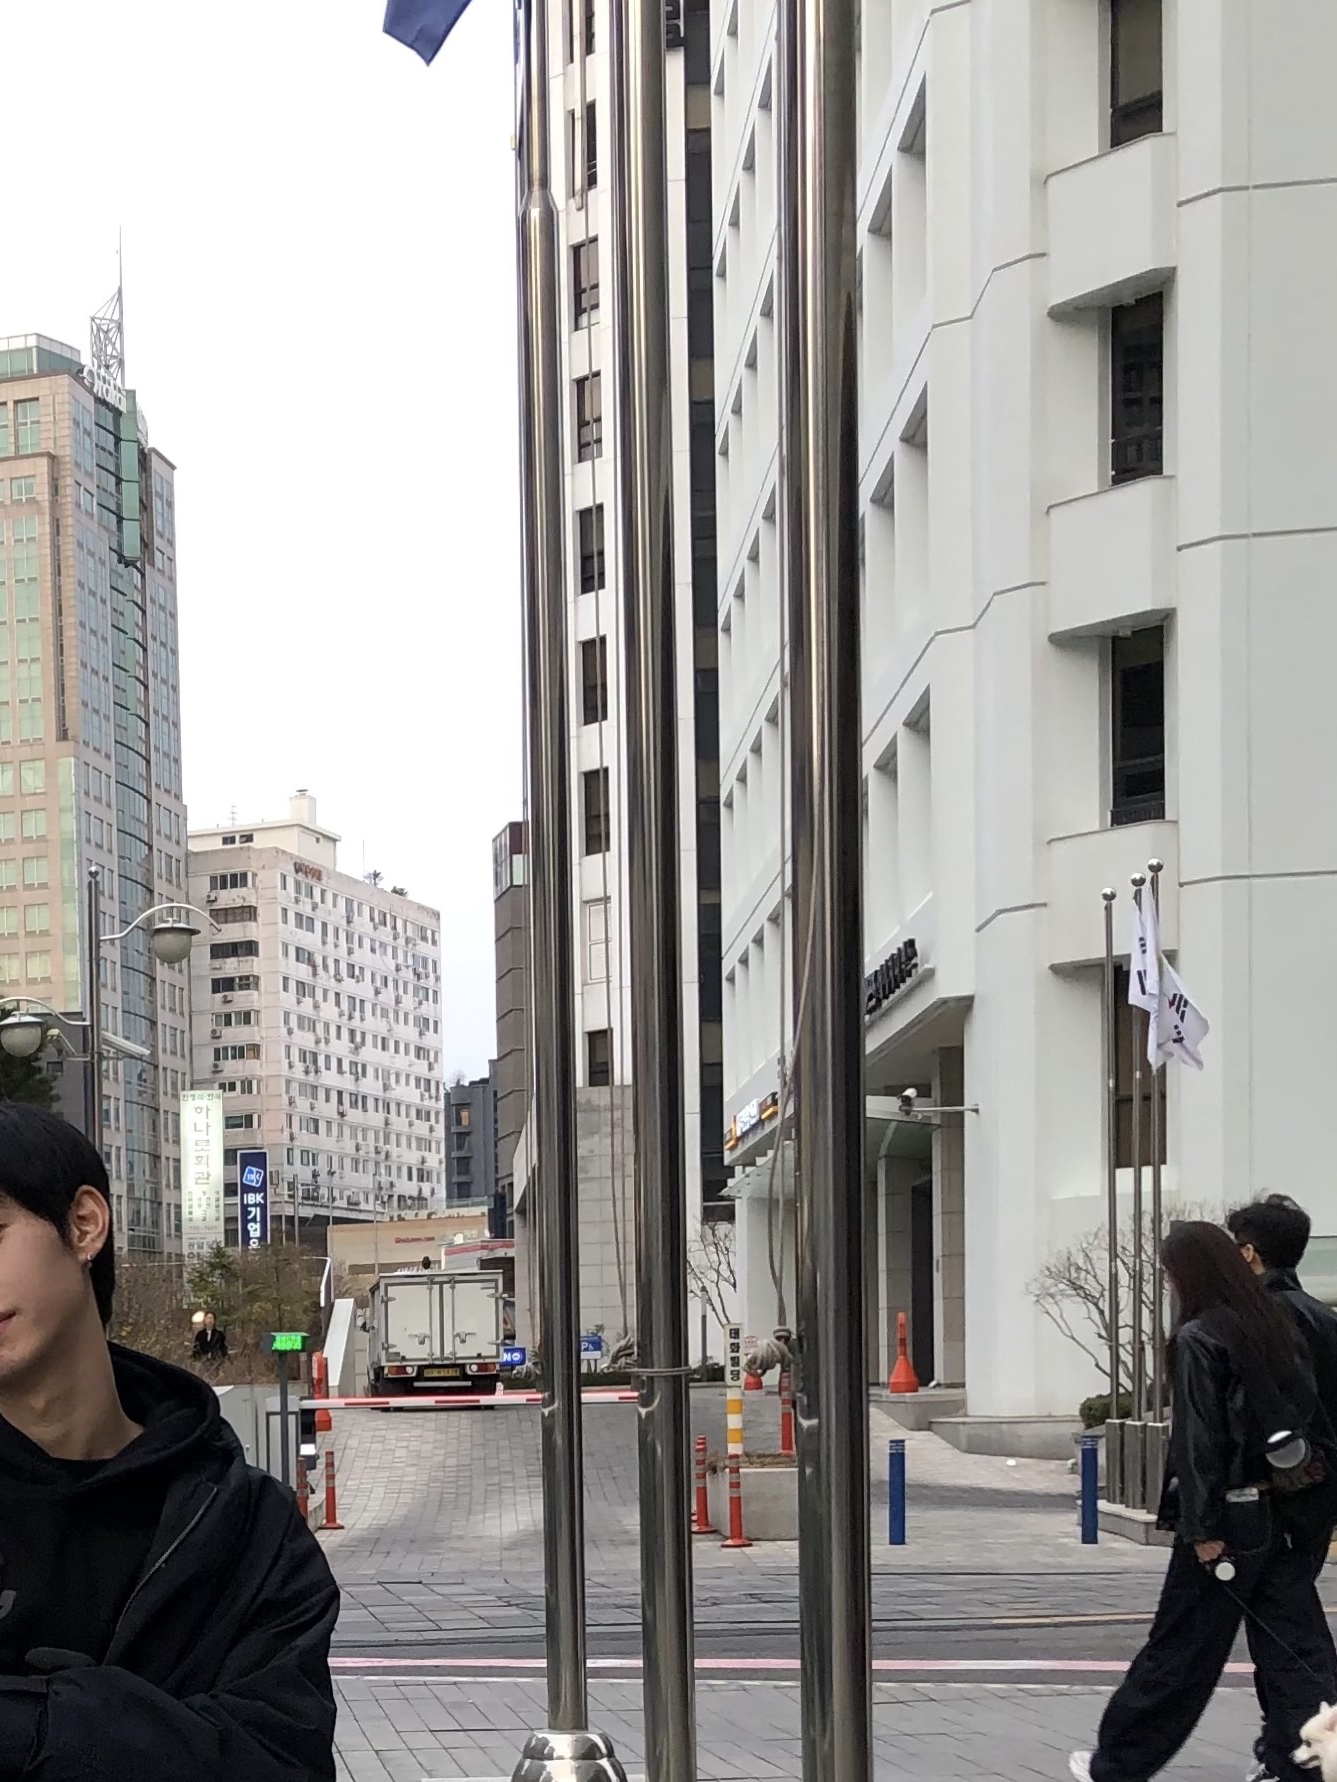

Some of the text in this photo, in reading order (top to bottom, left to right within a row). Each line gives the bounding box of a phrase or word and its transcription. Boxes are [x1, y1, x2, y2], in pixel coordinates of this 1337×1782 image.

[193, 1104, 211, 1185] 하나로회관
[243, 1192, 265, 1205] IBK
[729, 1327, 741, 1382] 태화빌딩
